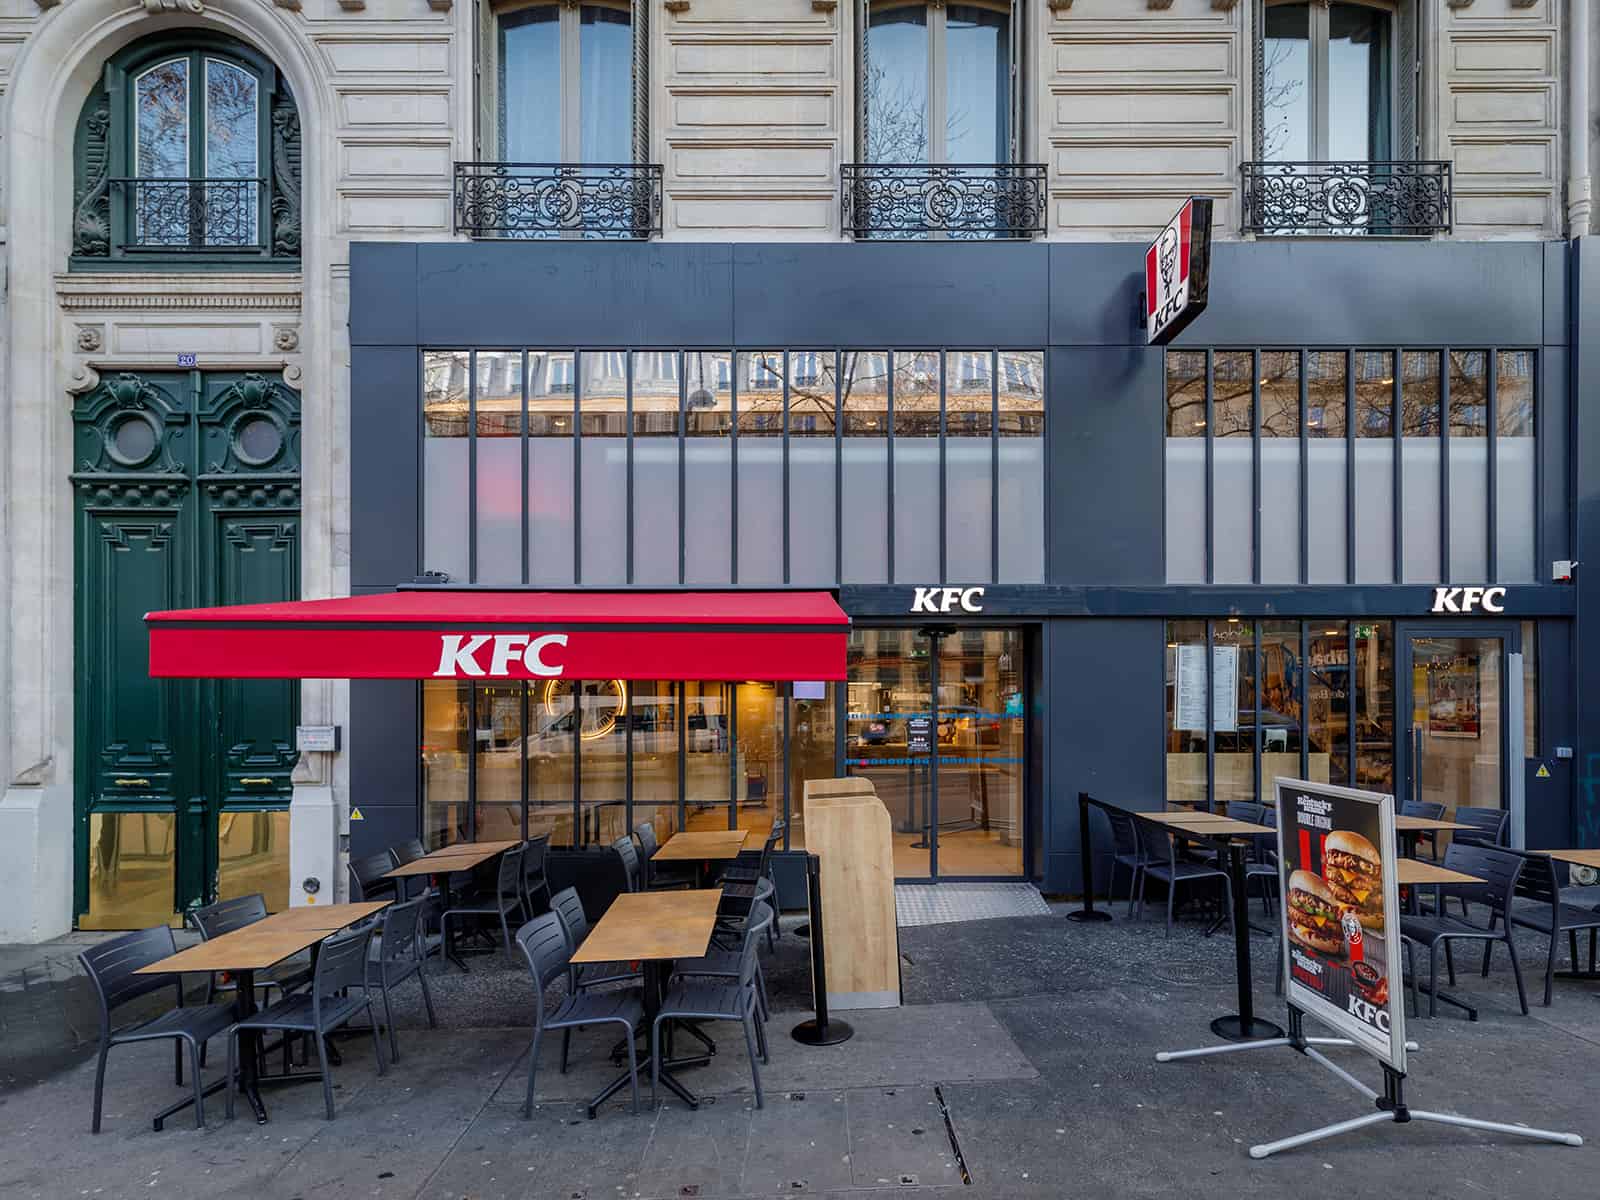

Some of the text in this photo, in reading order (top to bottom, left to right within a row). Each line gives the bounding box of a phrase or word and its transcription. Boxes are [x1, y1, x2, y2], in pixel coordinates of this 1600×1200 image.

[1153, 287, 1183, 335] KFC
[180, 355, 194, 365] 20
[910, 587, 985, 612] KFC
[1431, 587, 1507, 612] KFC
[433, 633, 569, 676] KFC
[1348, 993, 1390, 1033] KFC
